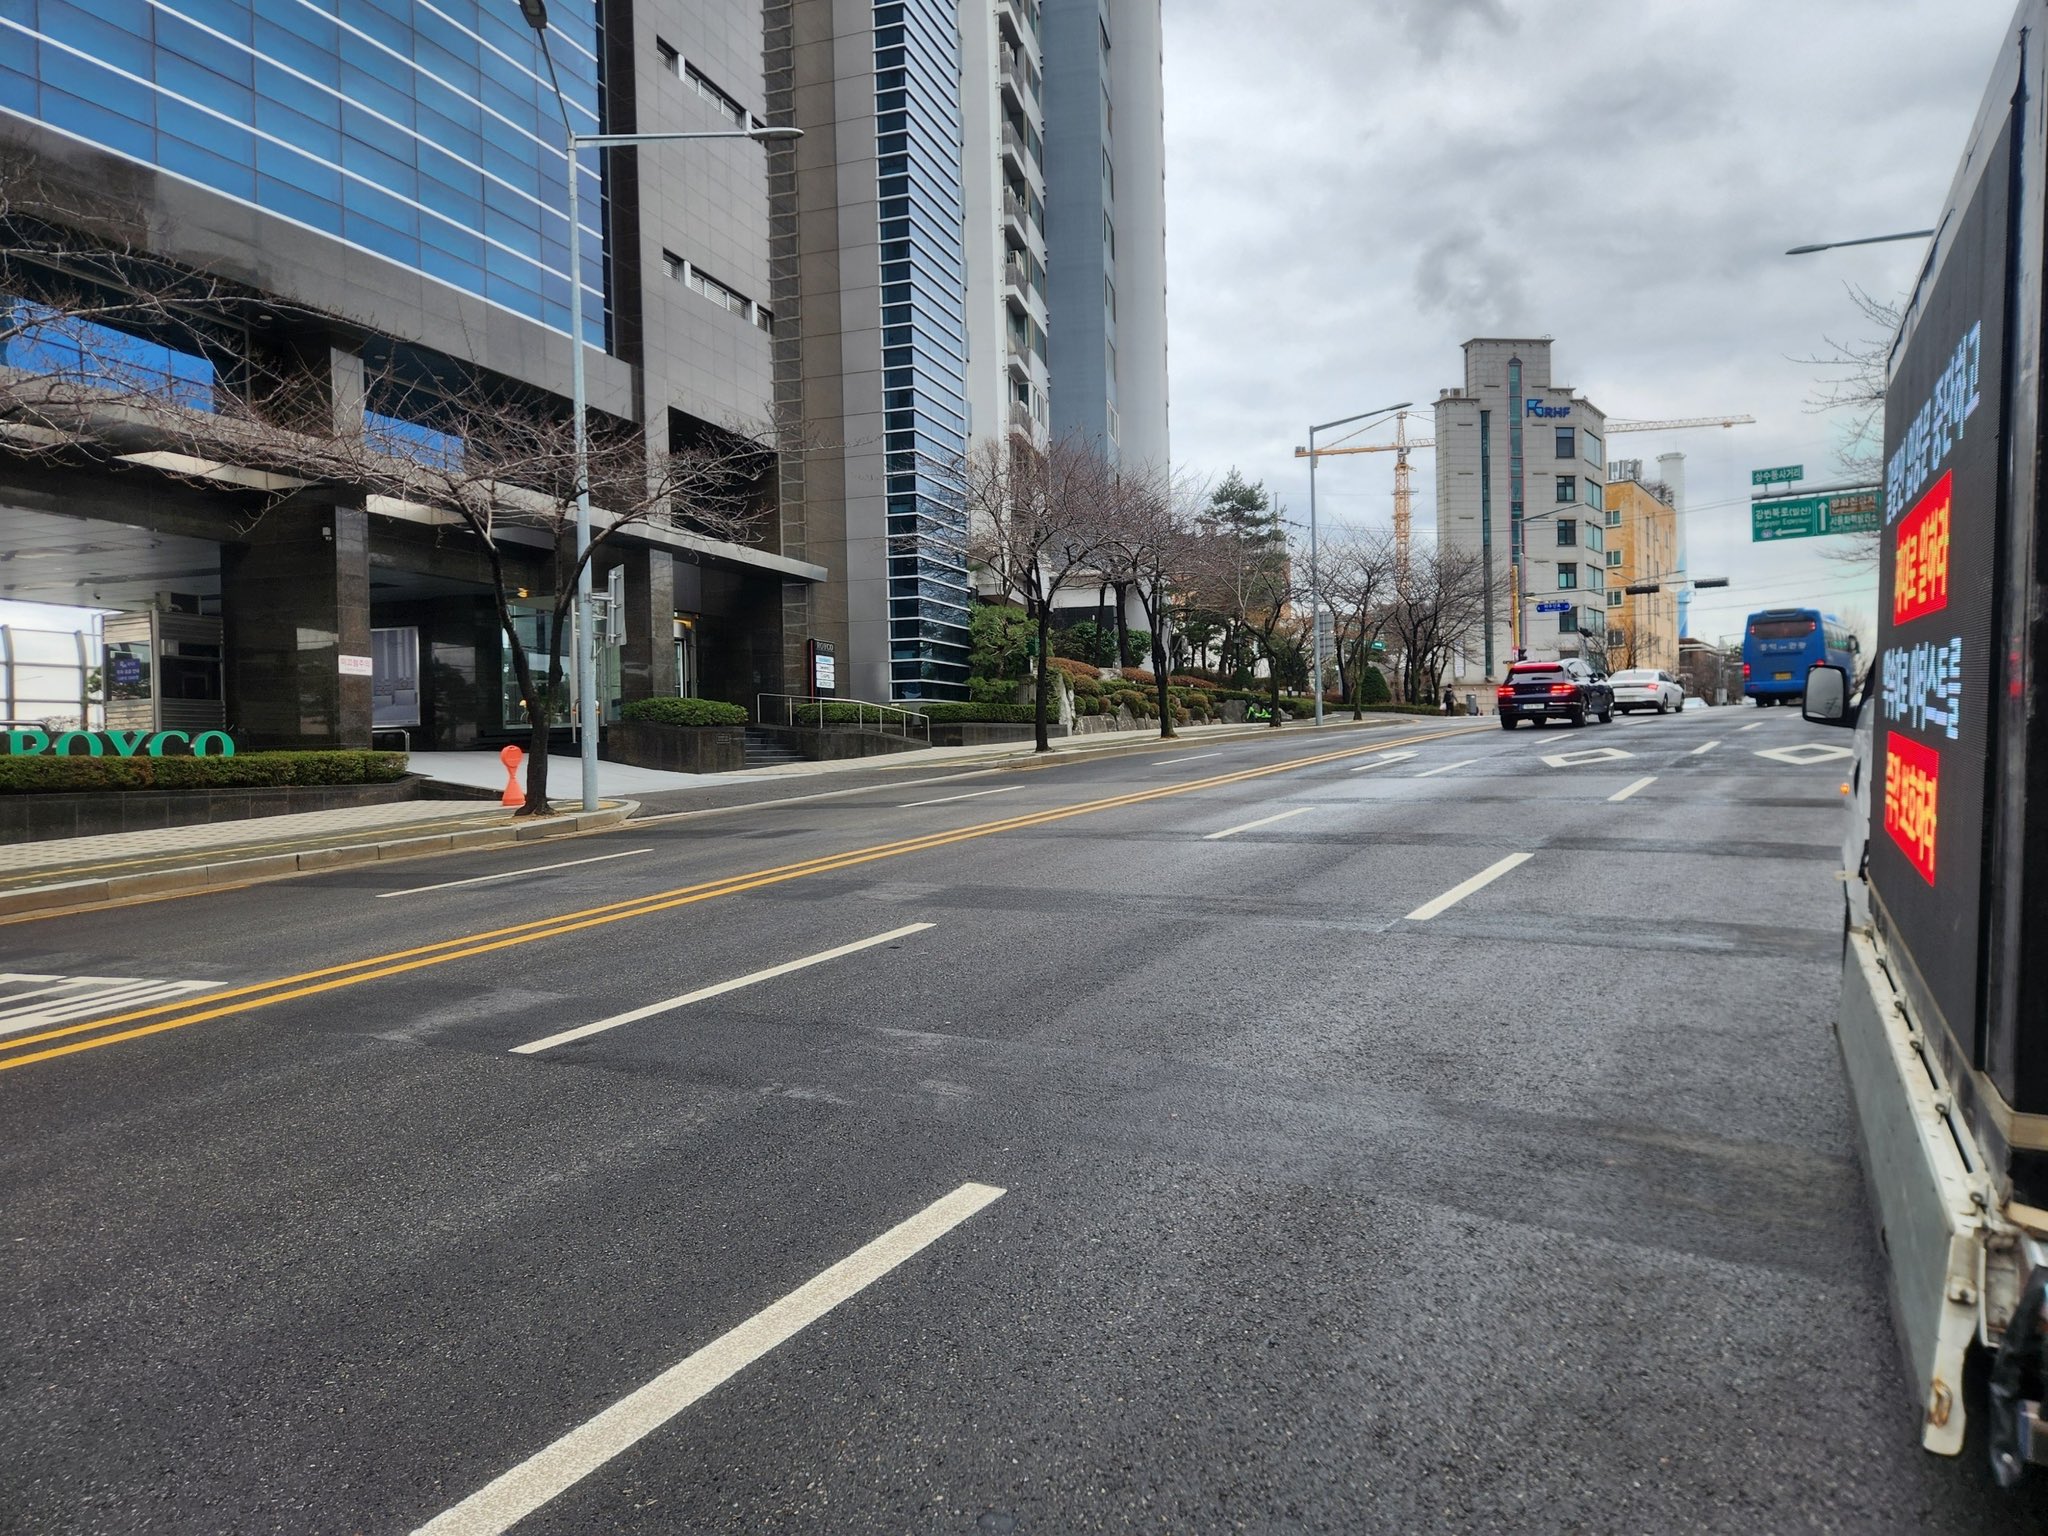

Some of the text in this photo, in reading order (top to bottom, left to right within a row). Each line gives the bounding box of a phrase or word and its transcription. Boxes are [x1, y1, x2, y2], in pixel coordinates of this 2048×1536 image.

[1905, 398, 1932, 503] 입장문
[1931, 320, 1982, 471] 중단하고
[1755, 467, 1800, 482] 상수동사거리
[1755, 505, 1812, 520] 강변북로(일산)
[1894, 497, 1950, 613] 제대로 일하라
[1908, 637, 1963, 740] 아티스트를
[1899, 764, 1938, 872] 보호하라
